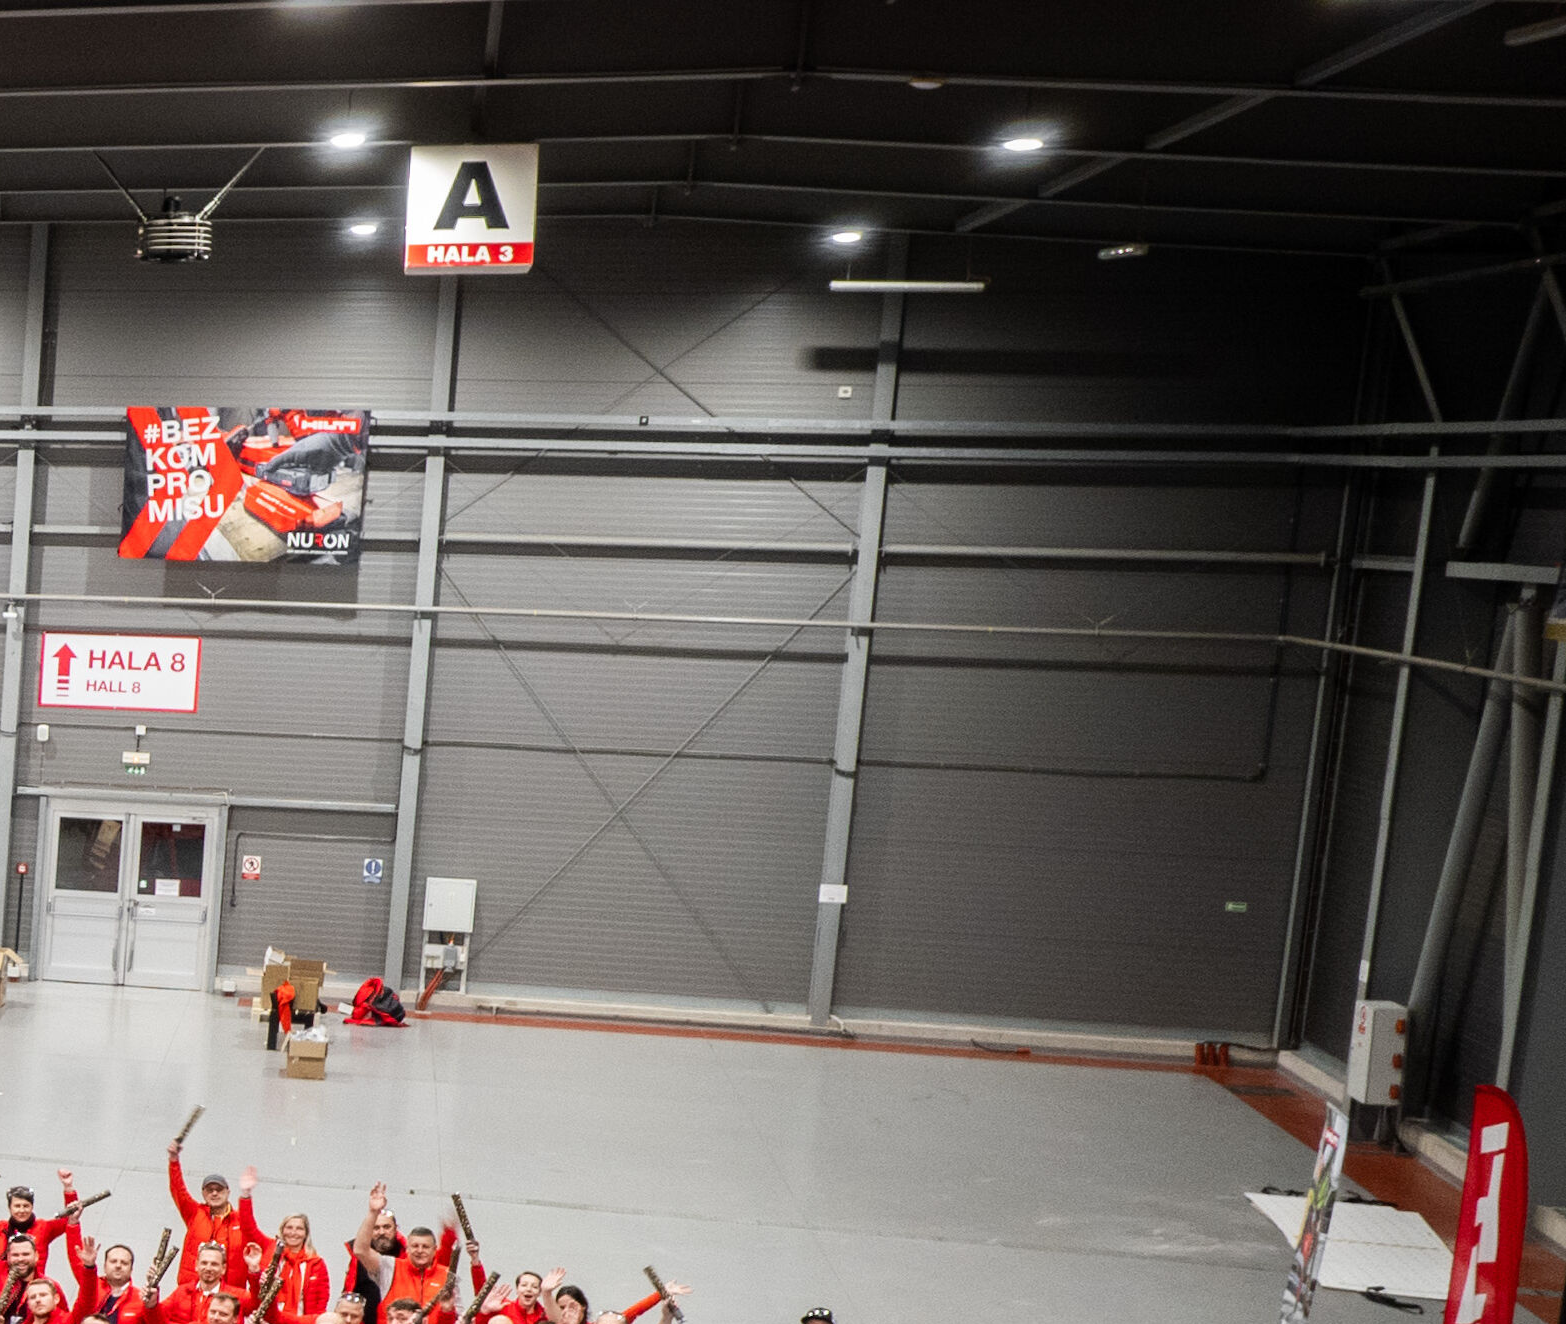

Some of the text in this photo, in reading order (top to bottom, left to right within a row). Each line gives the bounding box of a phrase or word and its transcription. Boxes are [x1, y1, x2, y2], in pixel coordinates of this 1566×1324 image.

[433, 161, 509, 230] A
[426, 245, 514, 263] HALA 3
[144, 416, 221, 444] #BEZ
[146, 442, 216, 472] KOM
[146, 469, 212, 497] PRO
[148, 494, 224, 523] MISU
[286, 532, 349, 550] NURON
[88, 649, 185, 673] HALA 8
[86, 680, 141, 694] HALL 8
